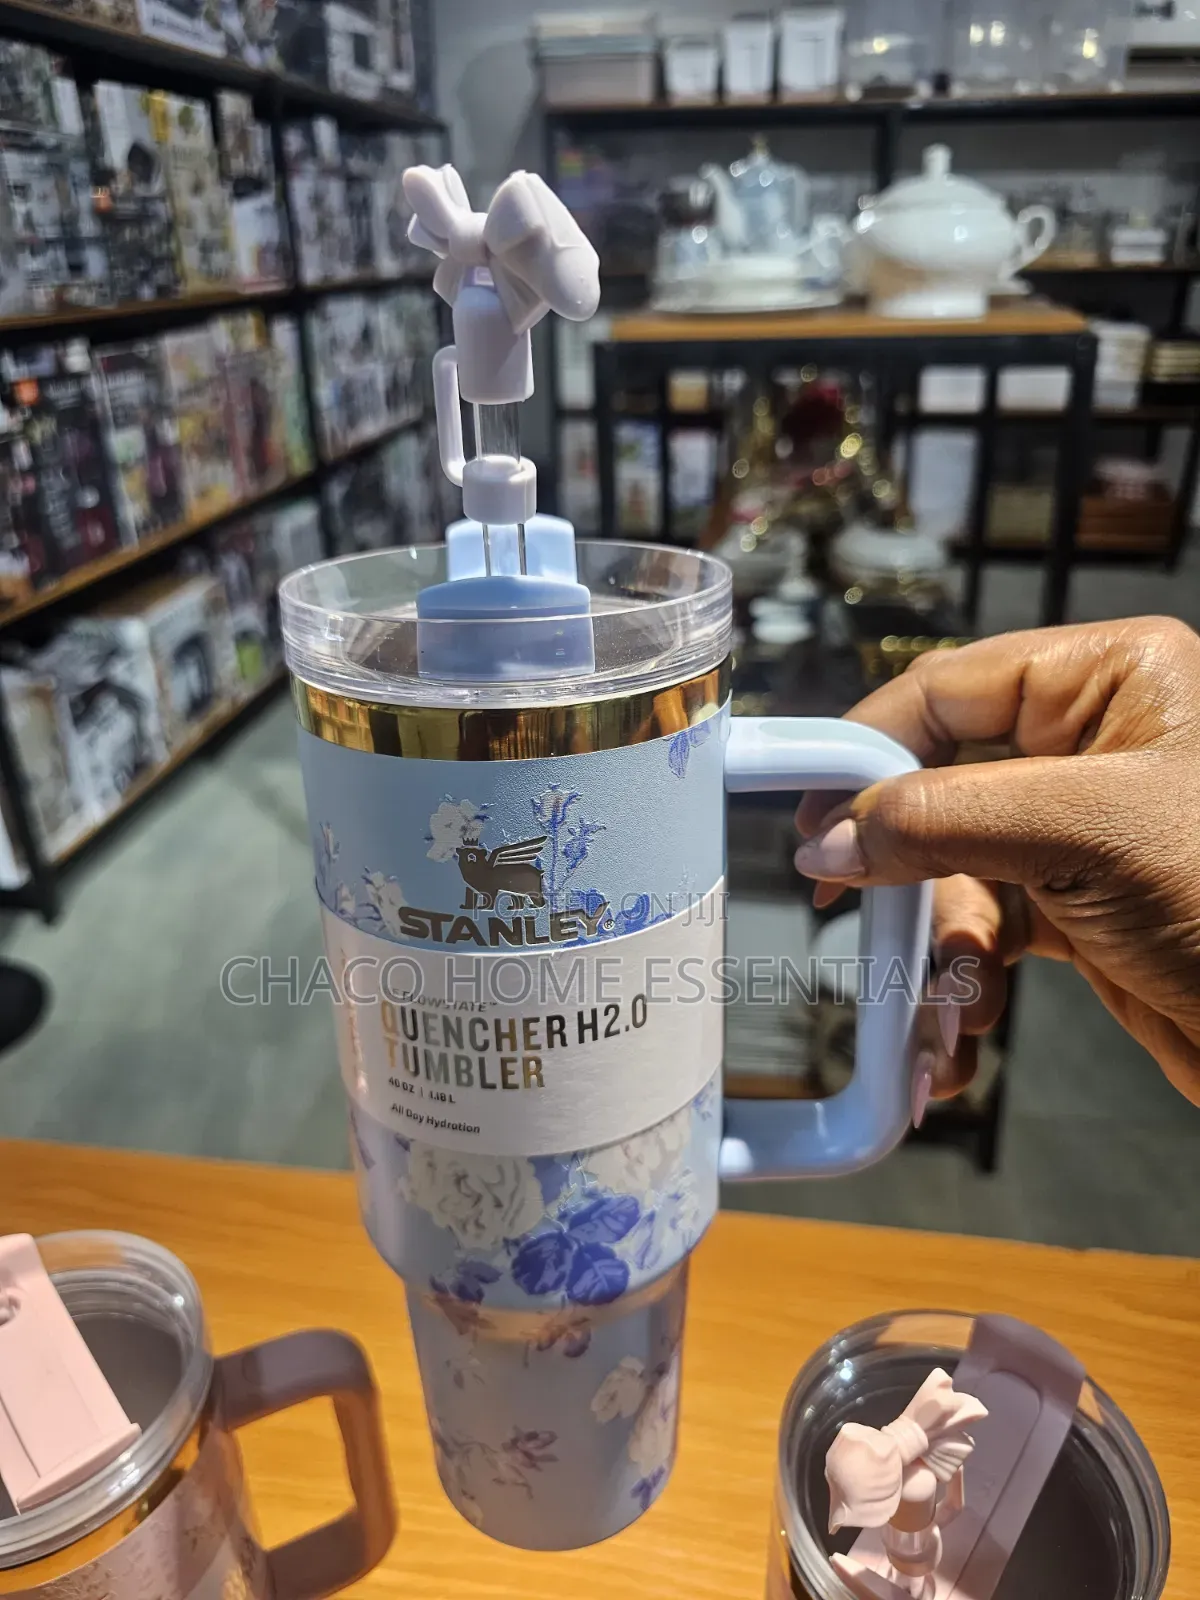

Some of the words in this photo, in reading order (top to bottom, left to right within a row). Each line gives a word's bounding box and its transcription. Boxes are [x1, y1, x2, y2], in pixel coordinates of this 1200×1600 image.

[381, 1000, 567, 1052] QUENCHER
[578, 994, 648, 1045] H2.0
[385, 1036, 546, 1090] TUMBLER
[389, 1076, 401, 1088] 40
[402, 1081, 416, 1094] OZ
[391, 1102, 404, 1115] All
[406, 1108, 425, 1124] Day
[426, 1115, 481, 1134] Hydration
